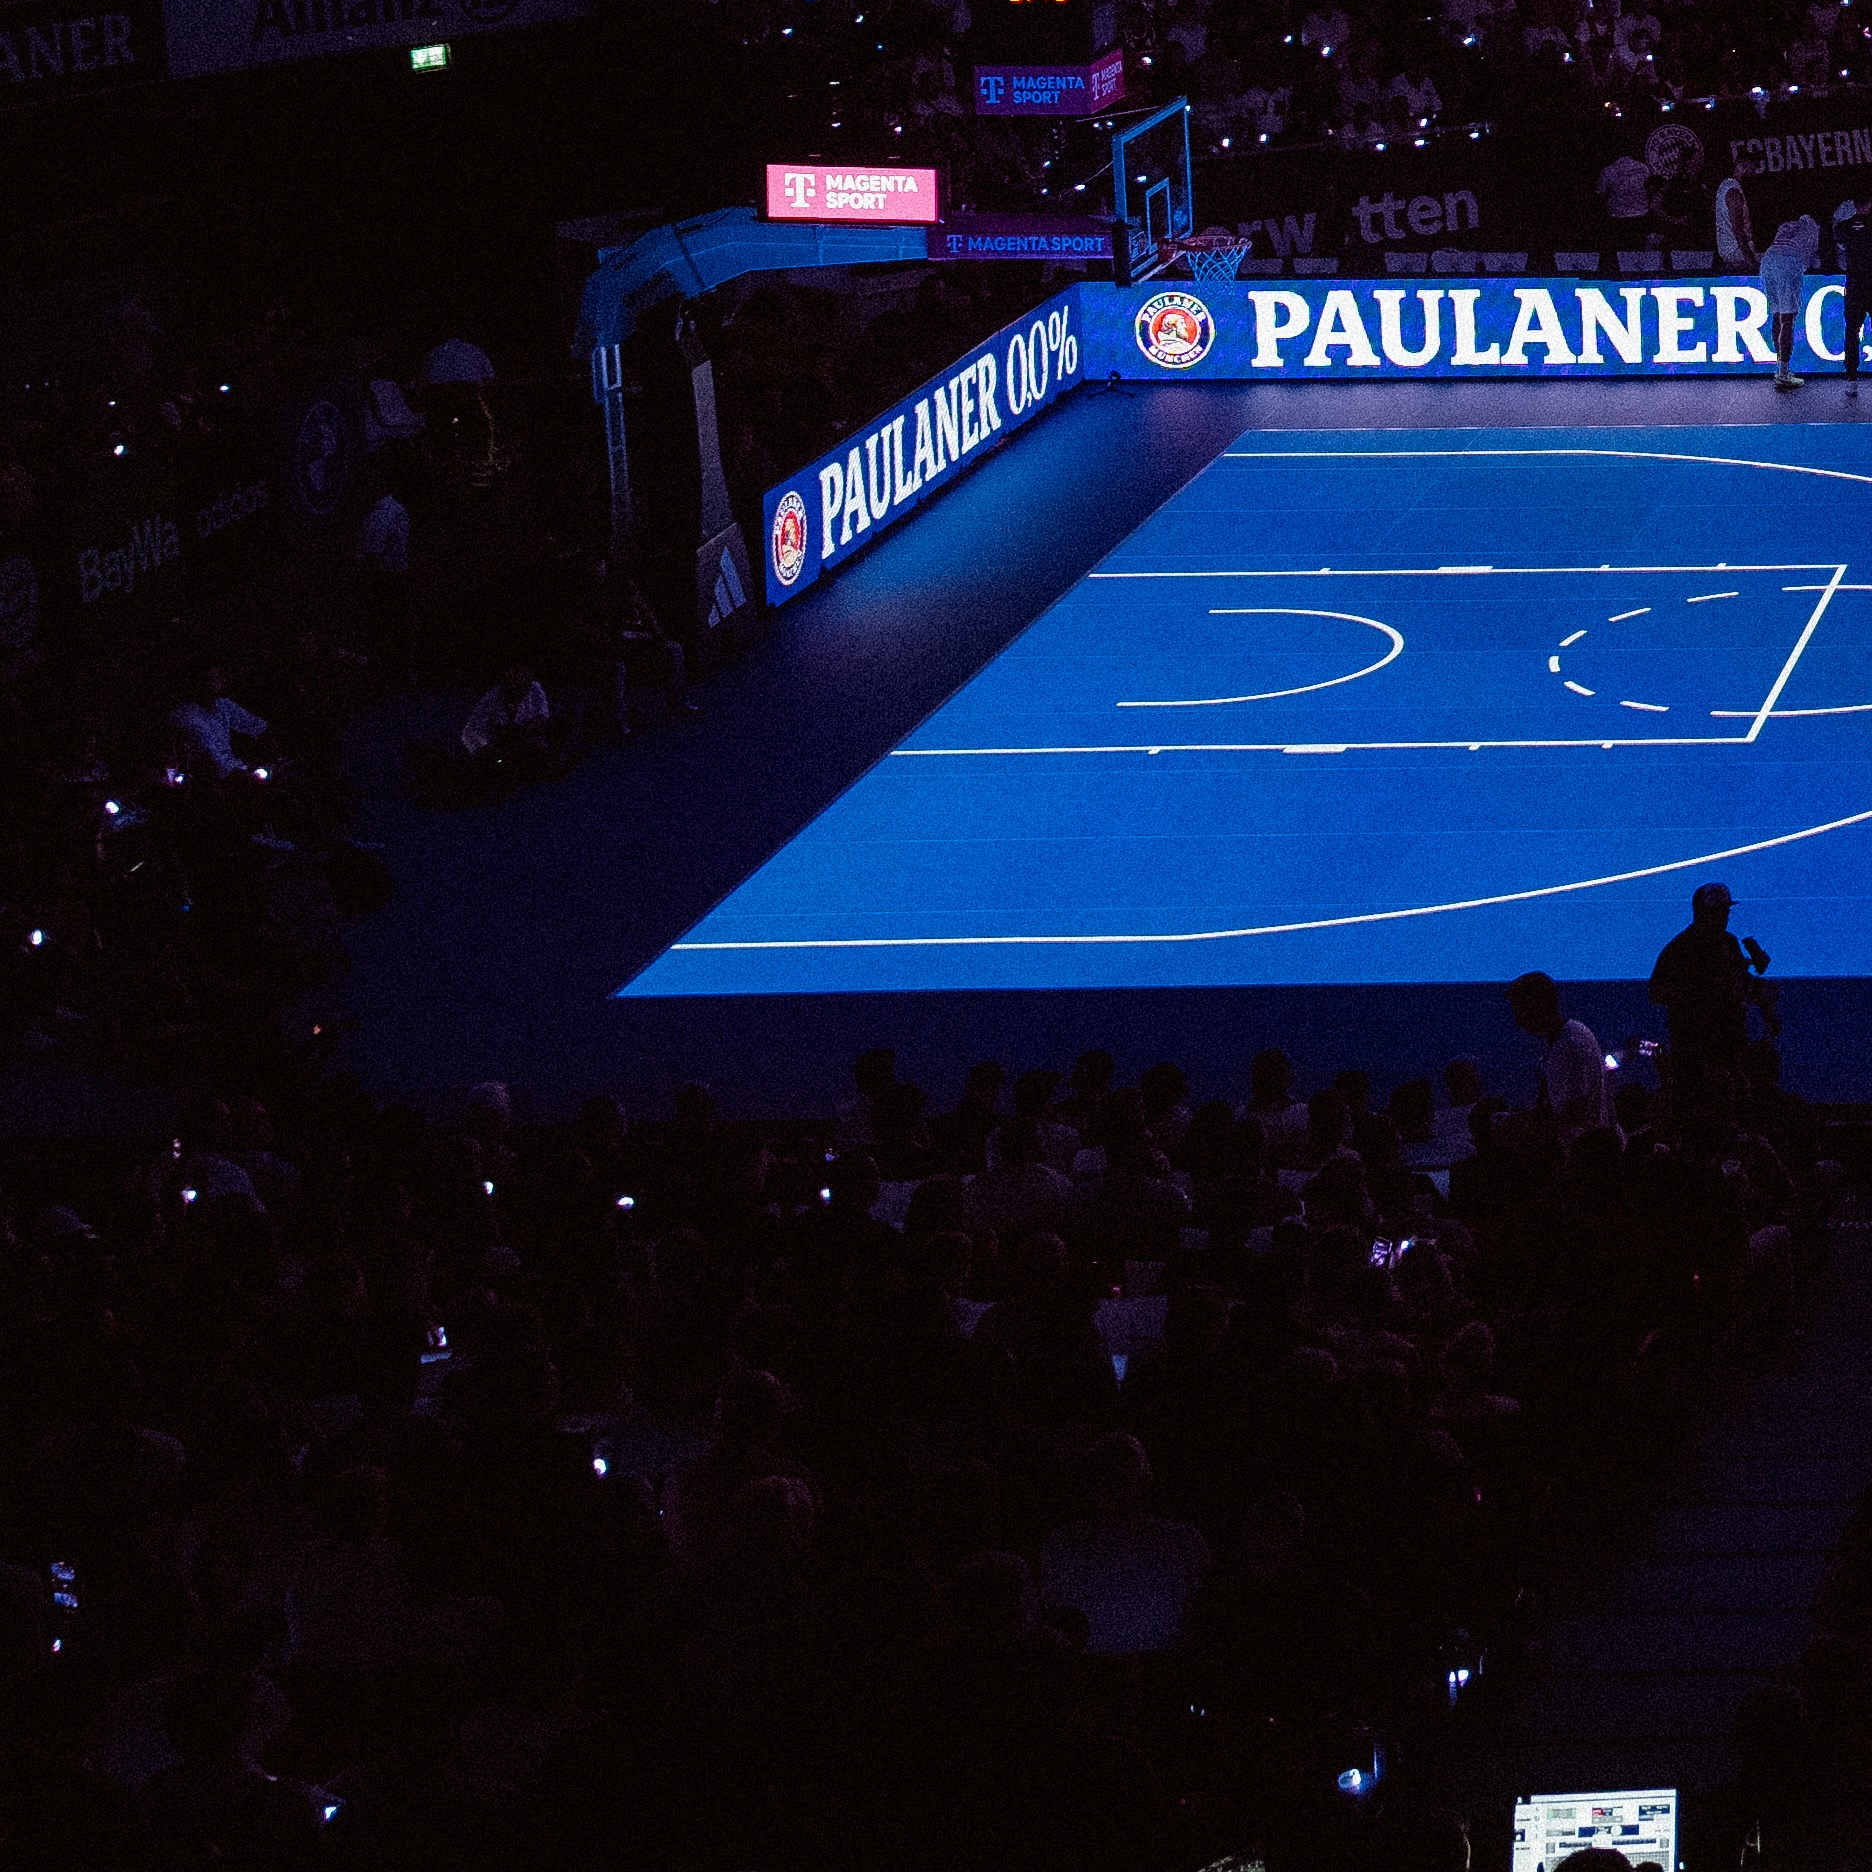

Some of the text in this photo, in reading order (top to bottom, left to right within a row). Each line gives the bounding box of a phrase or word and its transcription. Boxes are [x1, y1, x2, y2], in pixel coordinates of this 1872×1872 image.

[1011, 76, 1086, 90] MAGENTA
[1012, 91, 1061, 105] SPORT
[826, 174, 919, 193] MAGENTA
[825, 192, 887, 210] SPORT
[1248, 285, 1778, 368] PAULANER
[819, 353, 1002, 560] PAULANER
[1006, 305, 1078, 416] 0,0%
[77, 514, 182, 605] BayWa
